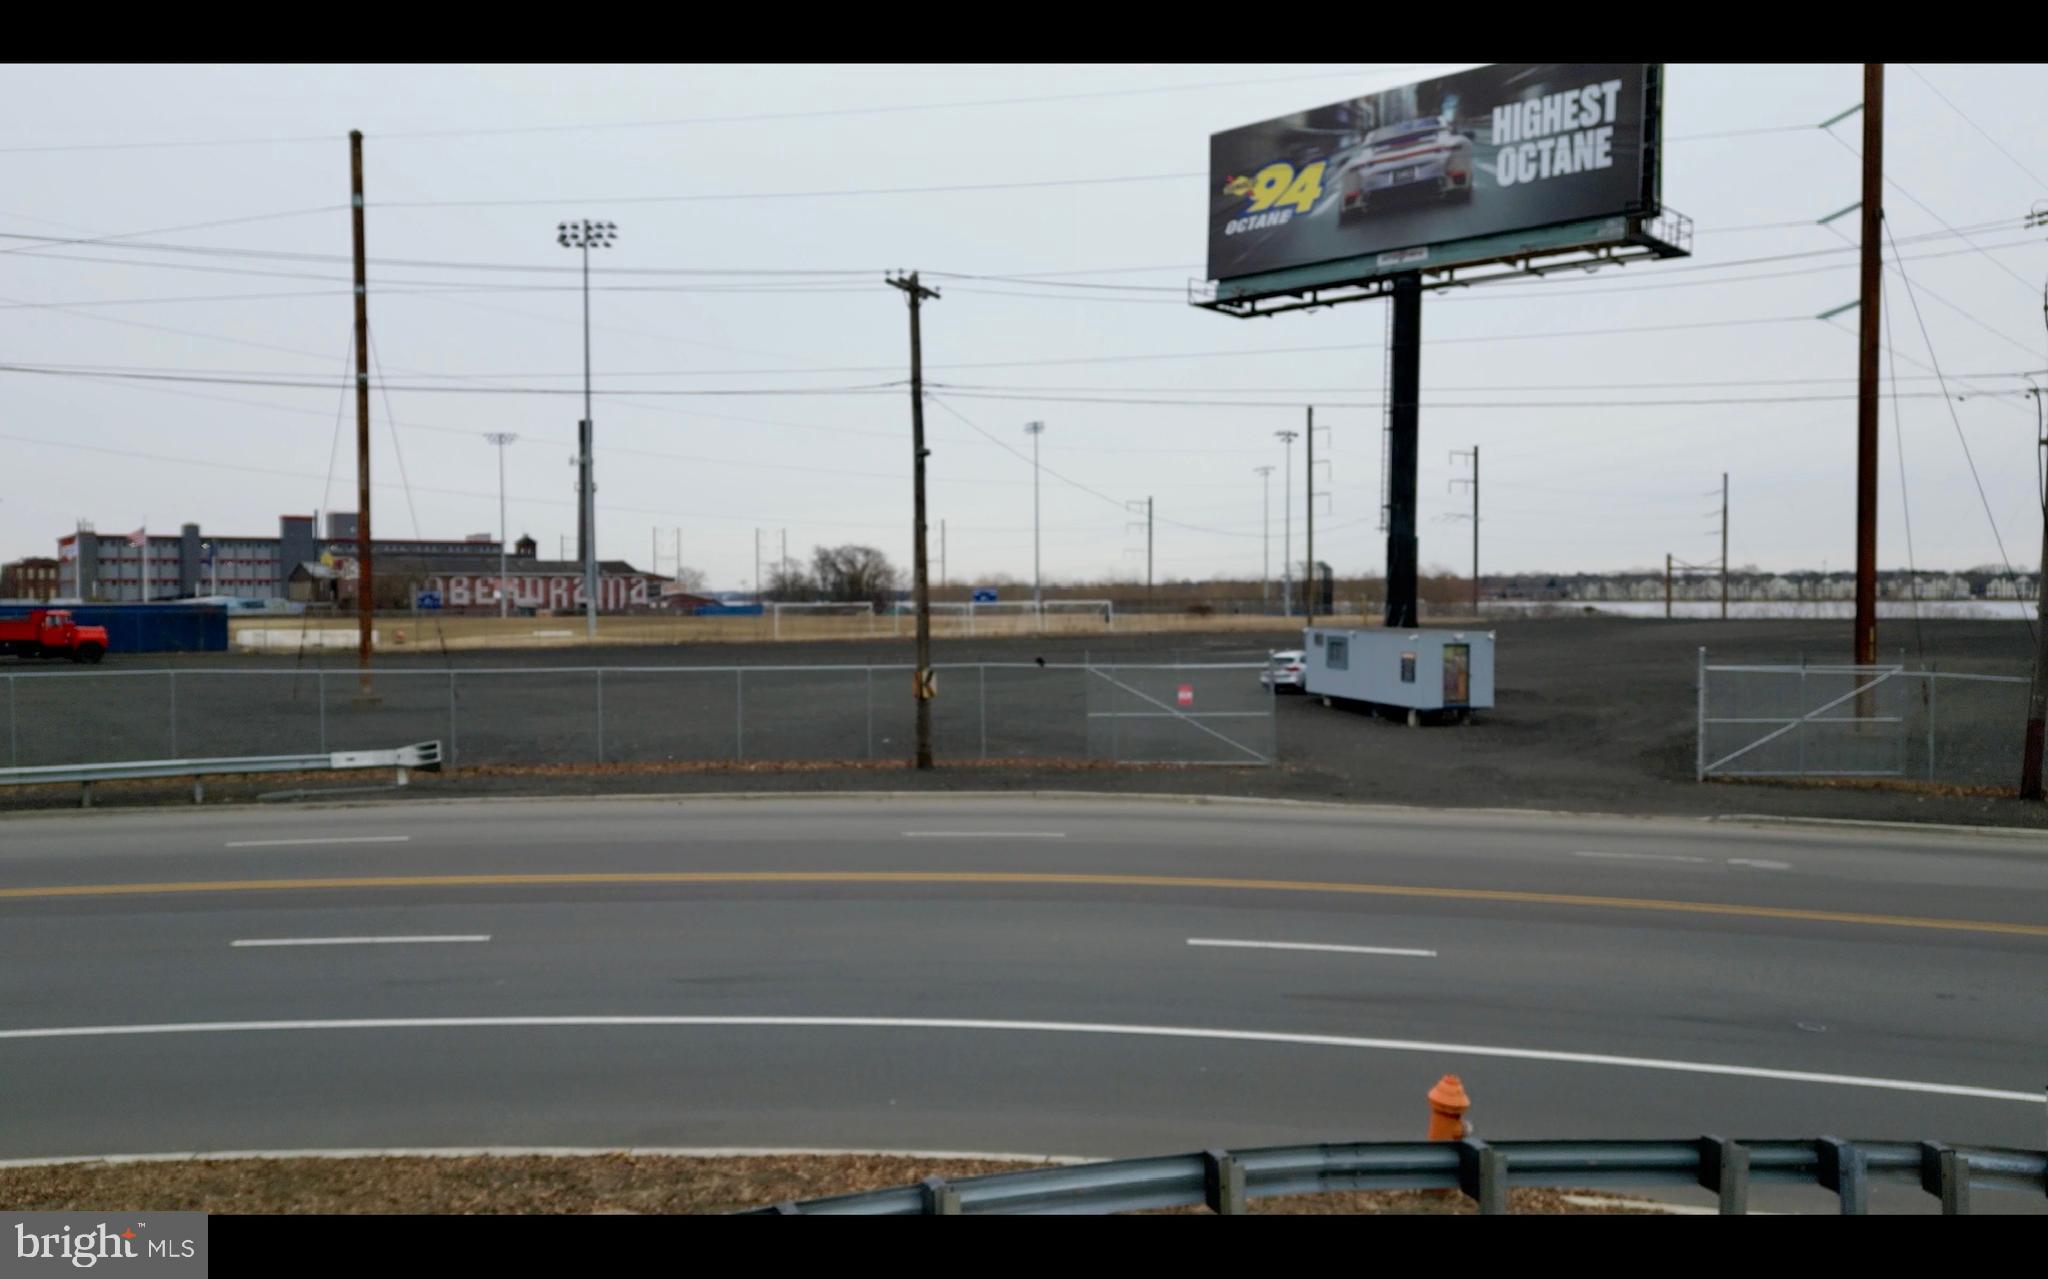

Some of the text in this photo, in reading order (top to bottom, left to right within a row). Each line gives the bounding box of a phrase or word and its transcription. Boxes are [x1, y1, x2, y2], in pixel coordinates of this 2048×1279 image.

[1492, 79, 1622, 146] HIGHEST
[1497, 125, 1613, 187] OCTANE
[1247, 161, 1326, 213] 94
[1225, 208, 1294, 235] OCTANE
